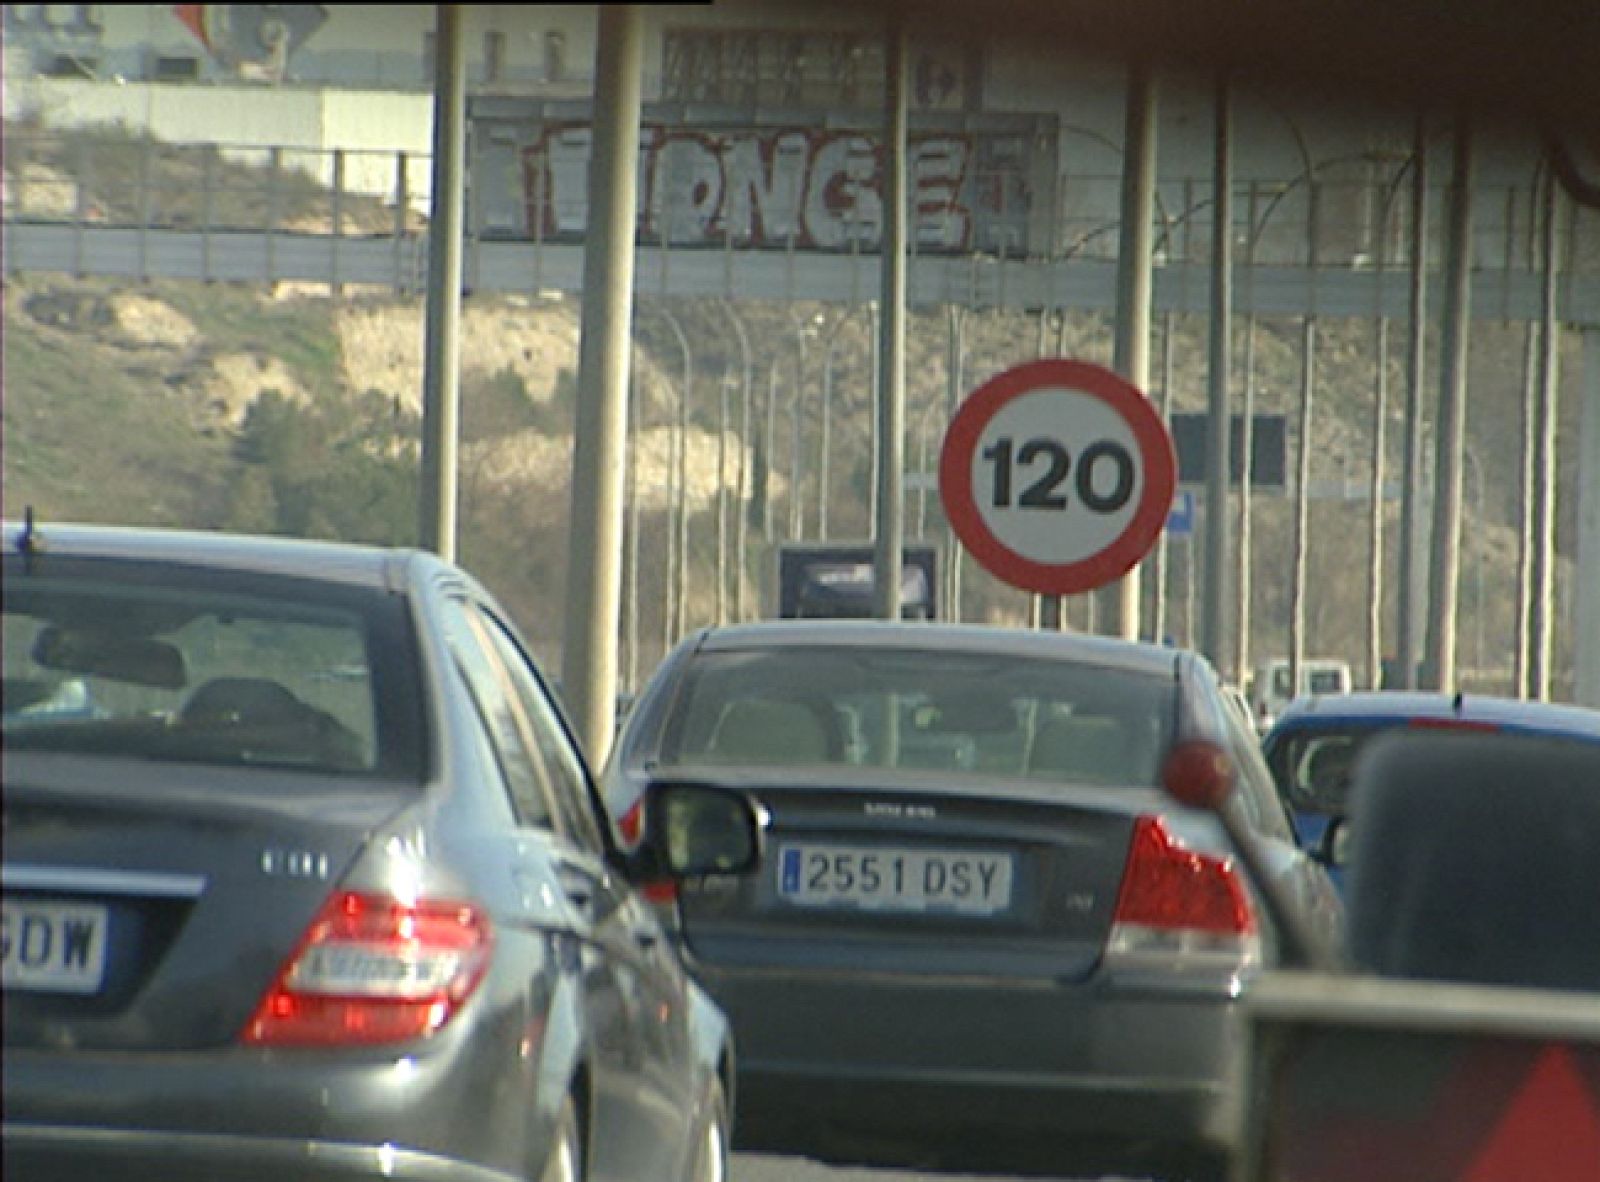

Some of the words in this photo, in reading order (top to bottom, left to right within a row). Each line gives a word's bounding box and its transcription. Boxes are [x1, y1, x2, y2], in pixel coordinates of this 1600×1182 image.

[983, 437, 1136, 514] 120
[807, 853, 904, 893] 2551
[923, 857, 997, 900] DSY
